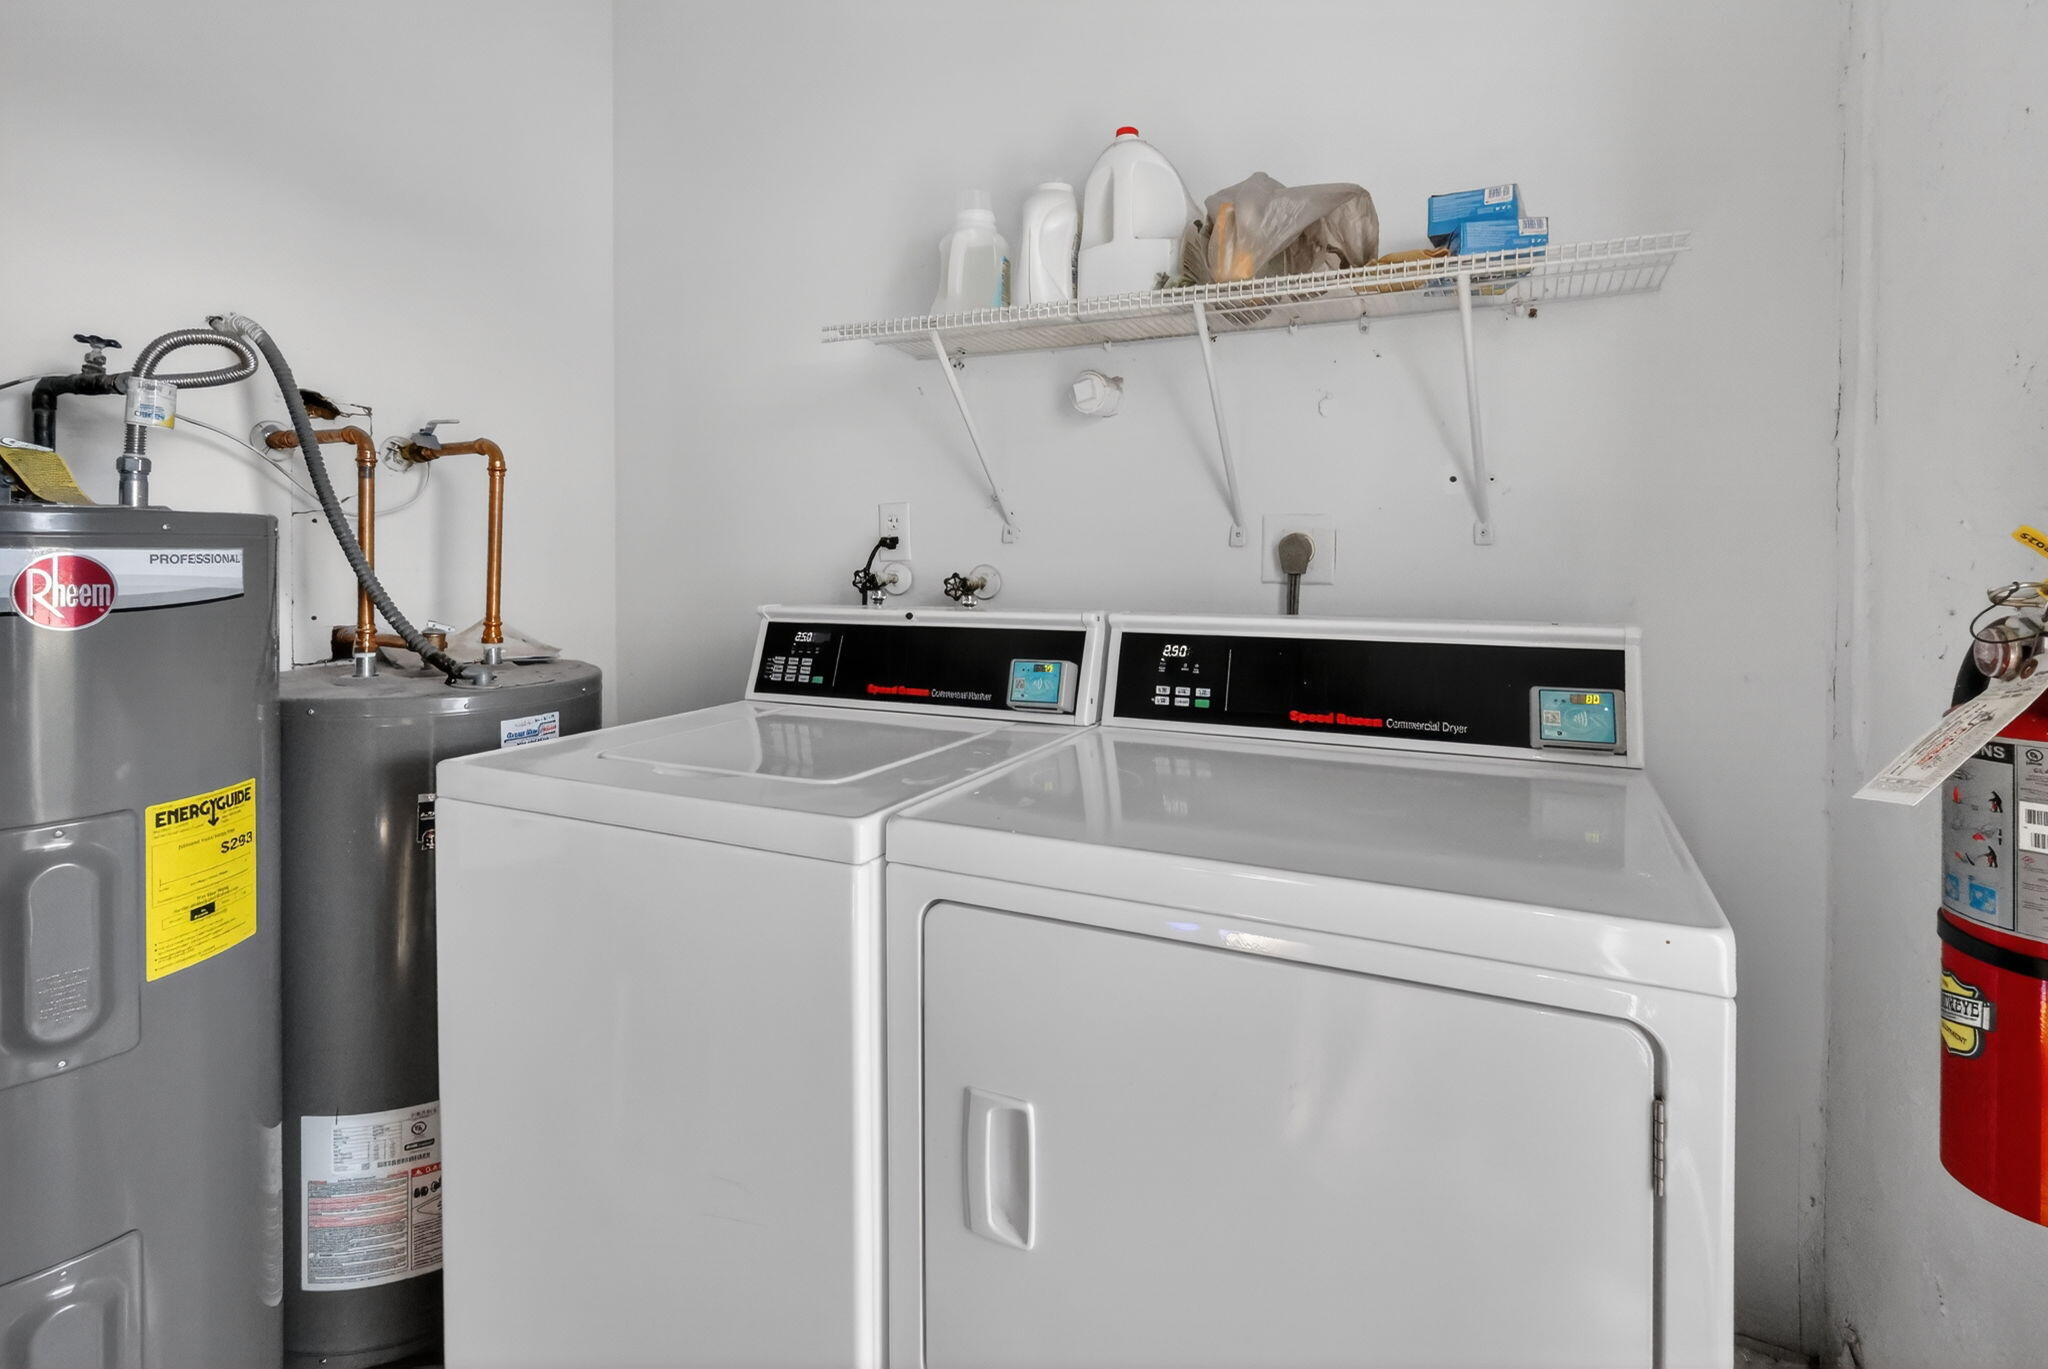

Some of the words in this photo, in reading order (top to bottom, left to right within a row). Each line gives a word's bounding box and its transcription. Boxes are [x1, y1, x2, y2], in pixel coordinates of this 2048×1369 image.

[149, 553, 241, 565] PROFESSIONAL
[26, 555, 112, 619] Rheem
[1386, 717, 1440, 733] Commercial
[1442, 721, 1468, 735] Dryer
[155, 786, 252, 828] ENERGYGUIDE
